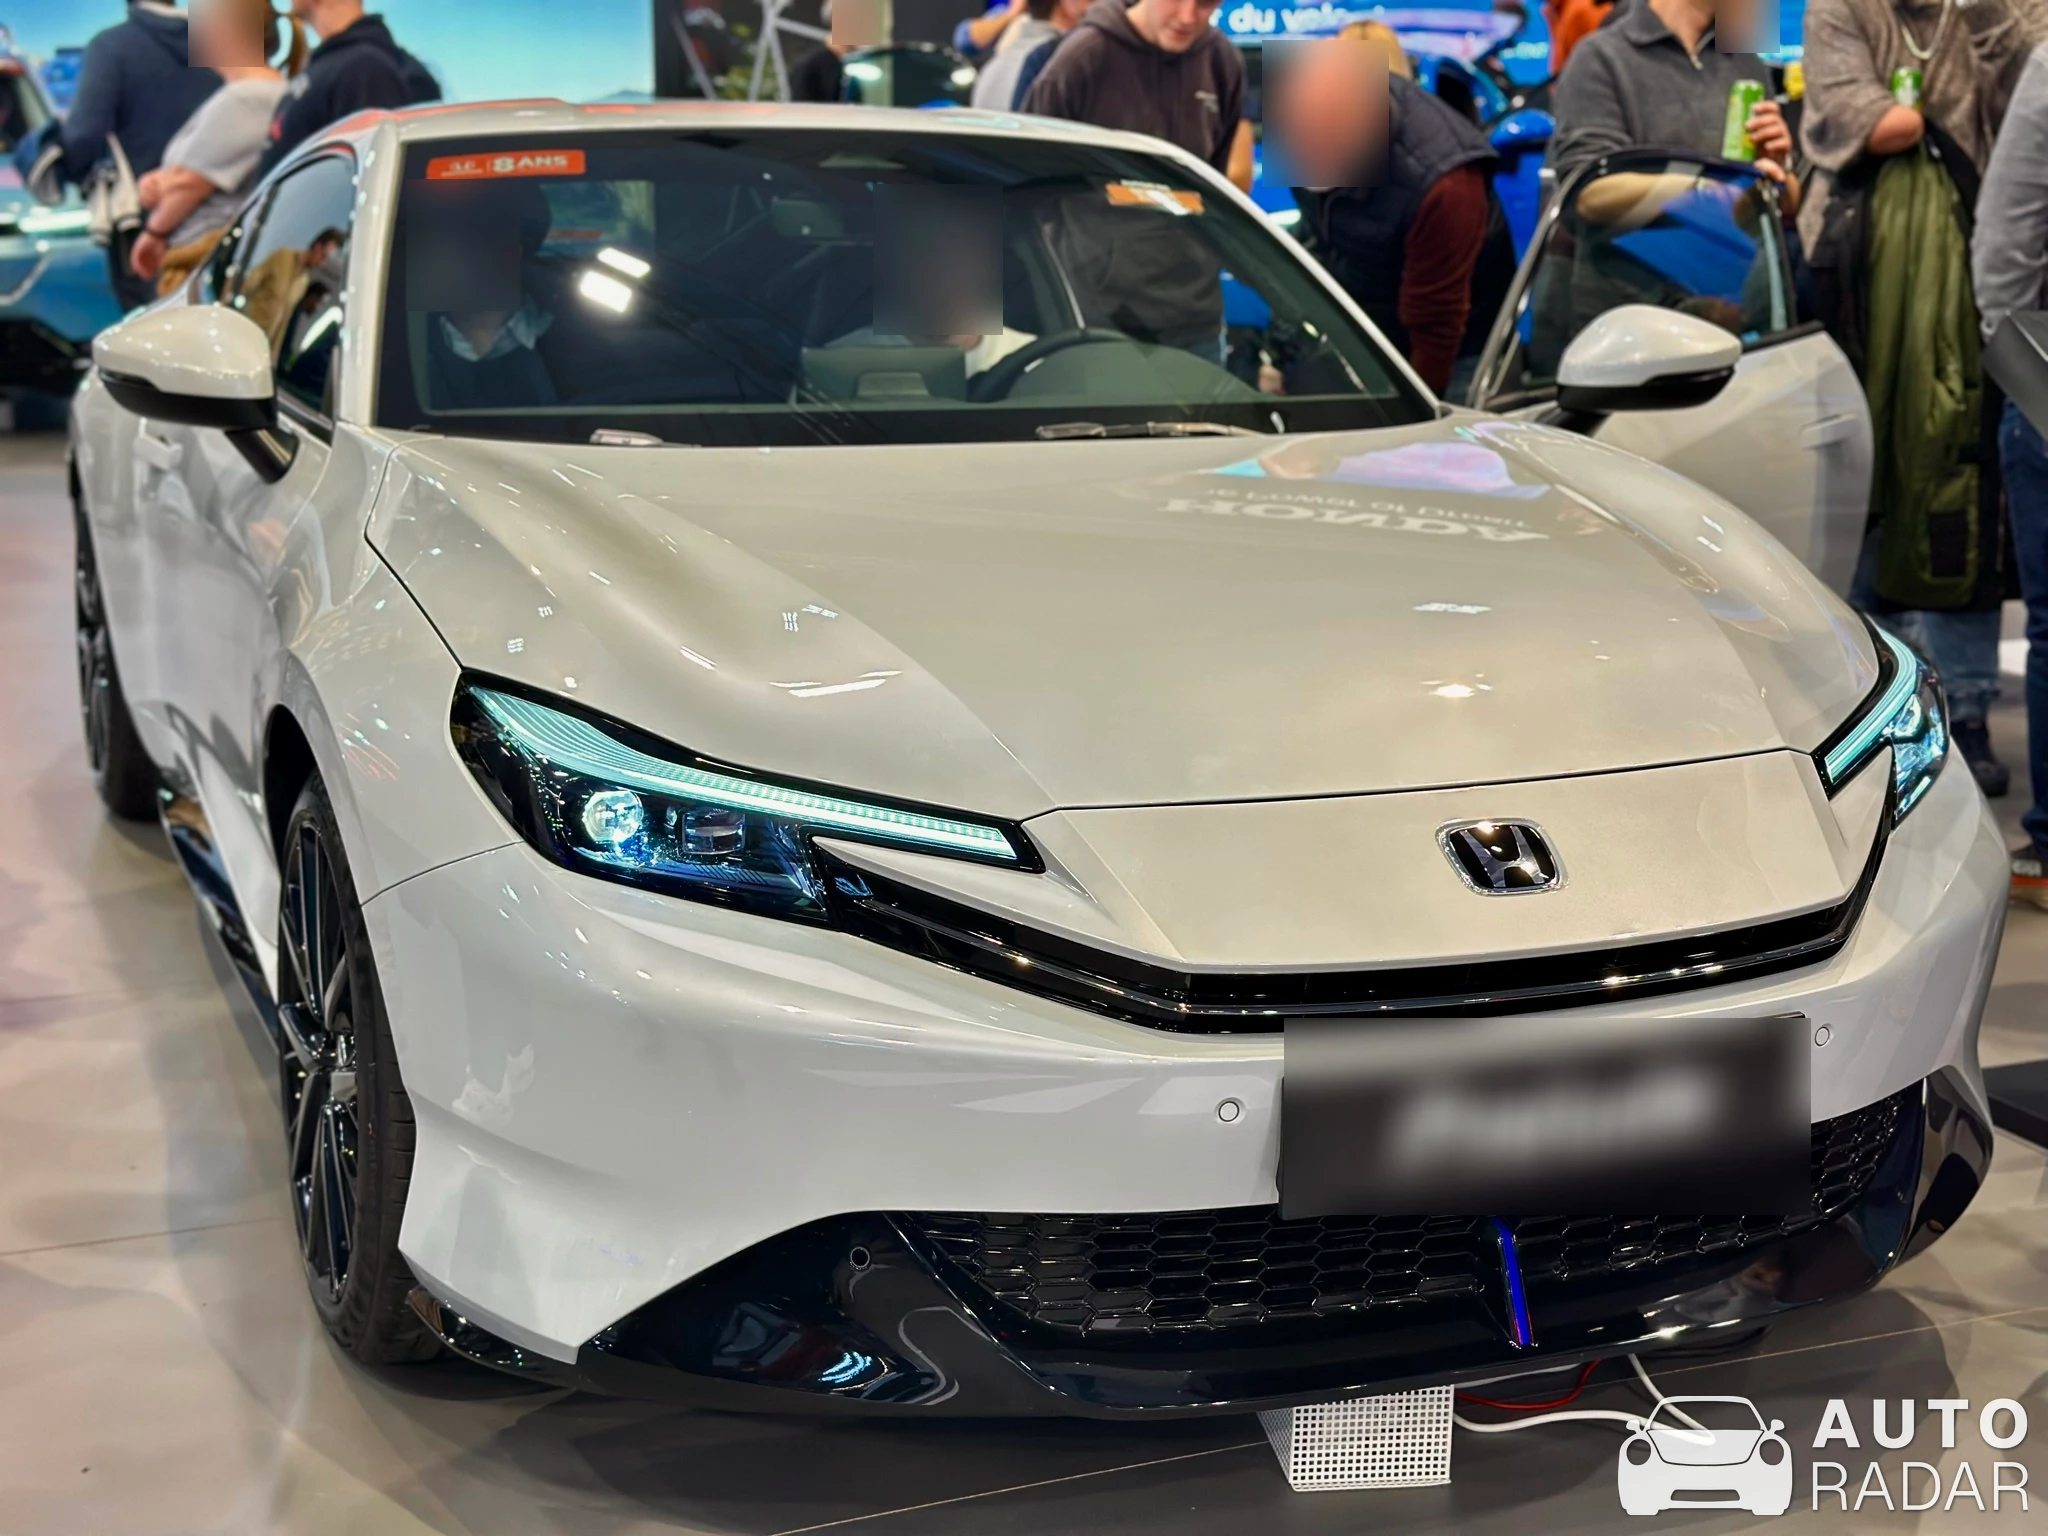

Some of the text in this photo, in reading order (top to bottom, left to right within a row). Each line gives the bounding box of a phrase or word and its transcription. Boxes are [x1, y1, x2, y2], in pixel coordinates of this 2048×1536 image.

[1228, 1, 1276, 33] du
[493, 157, 515, 174] 8
[517, 155, 568, 170] ANS
